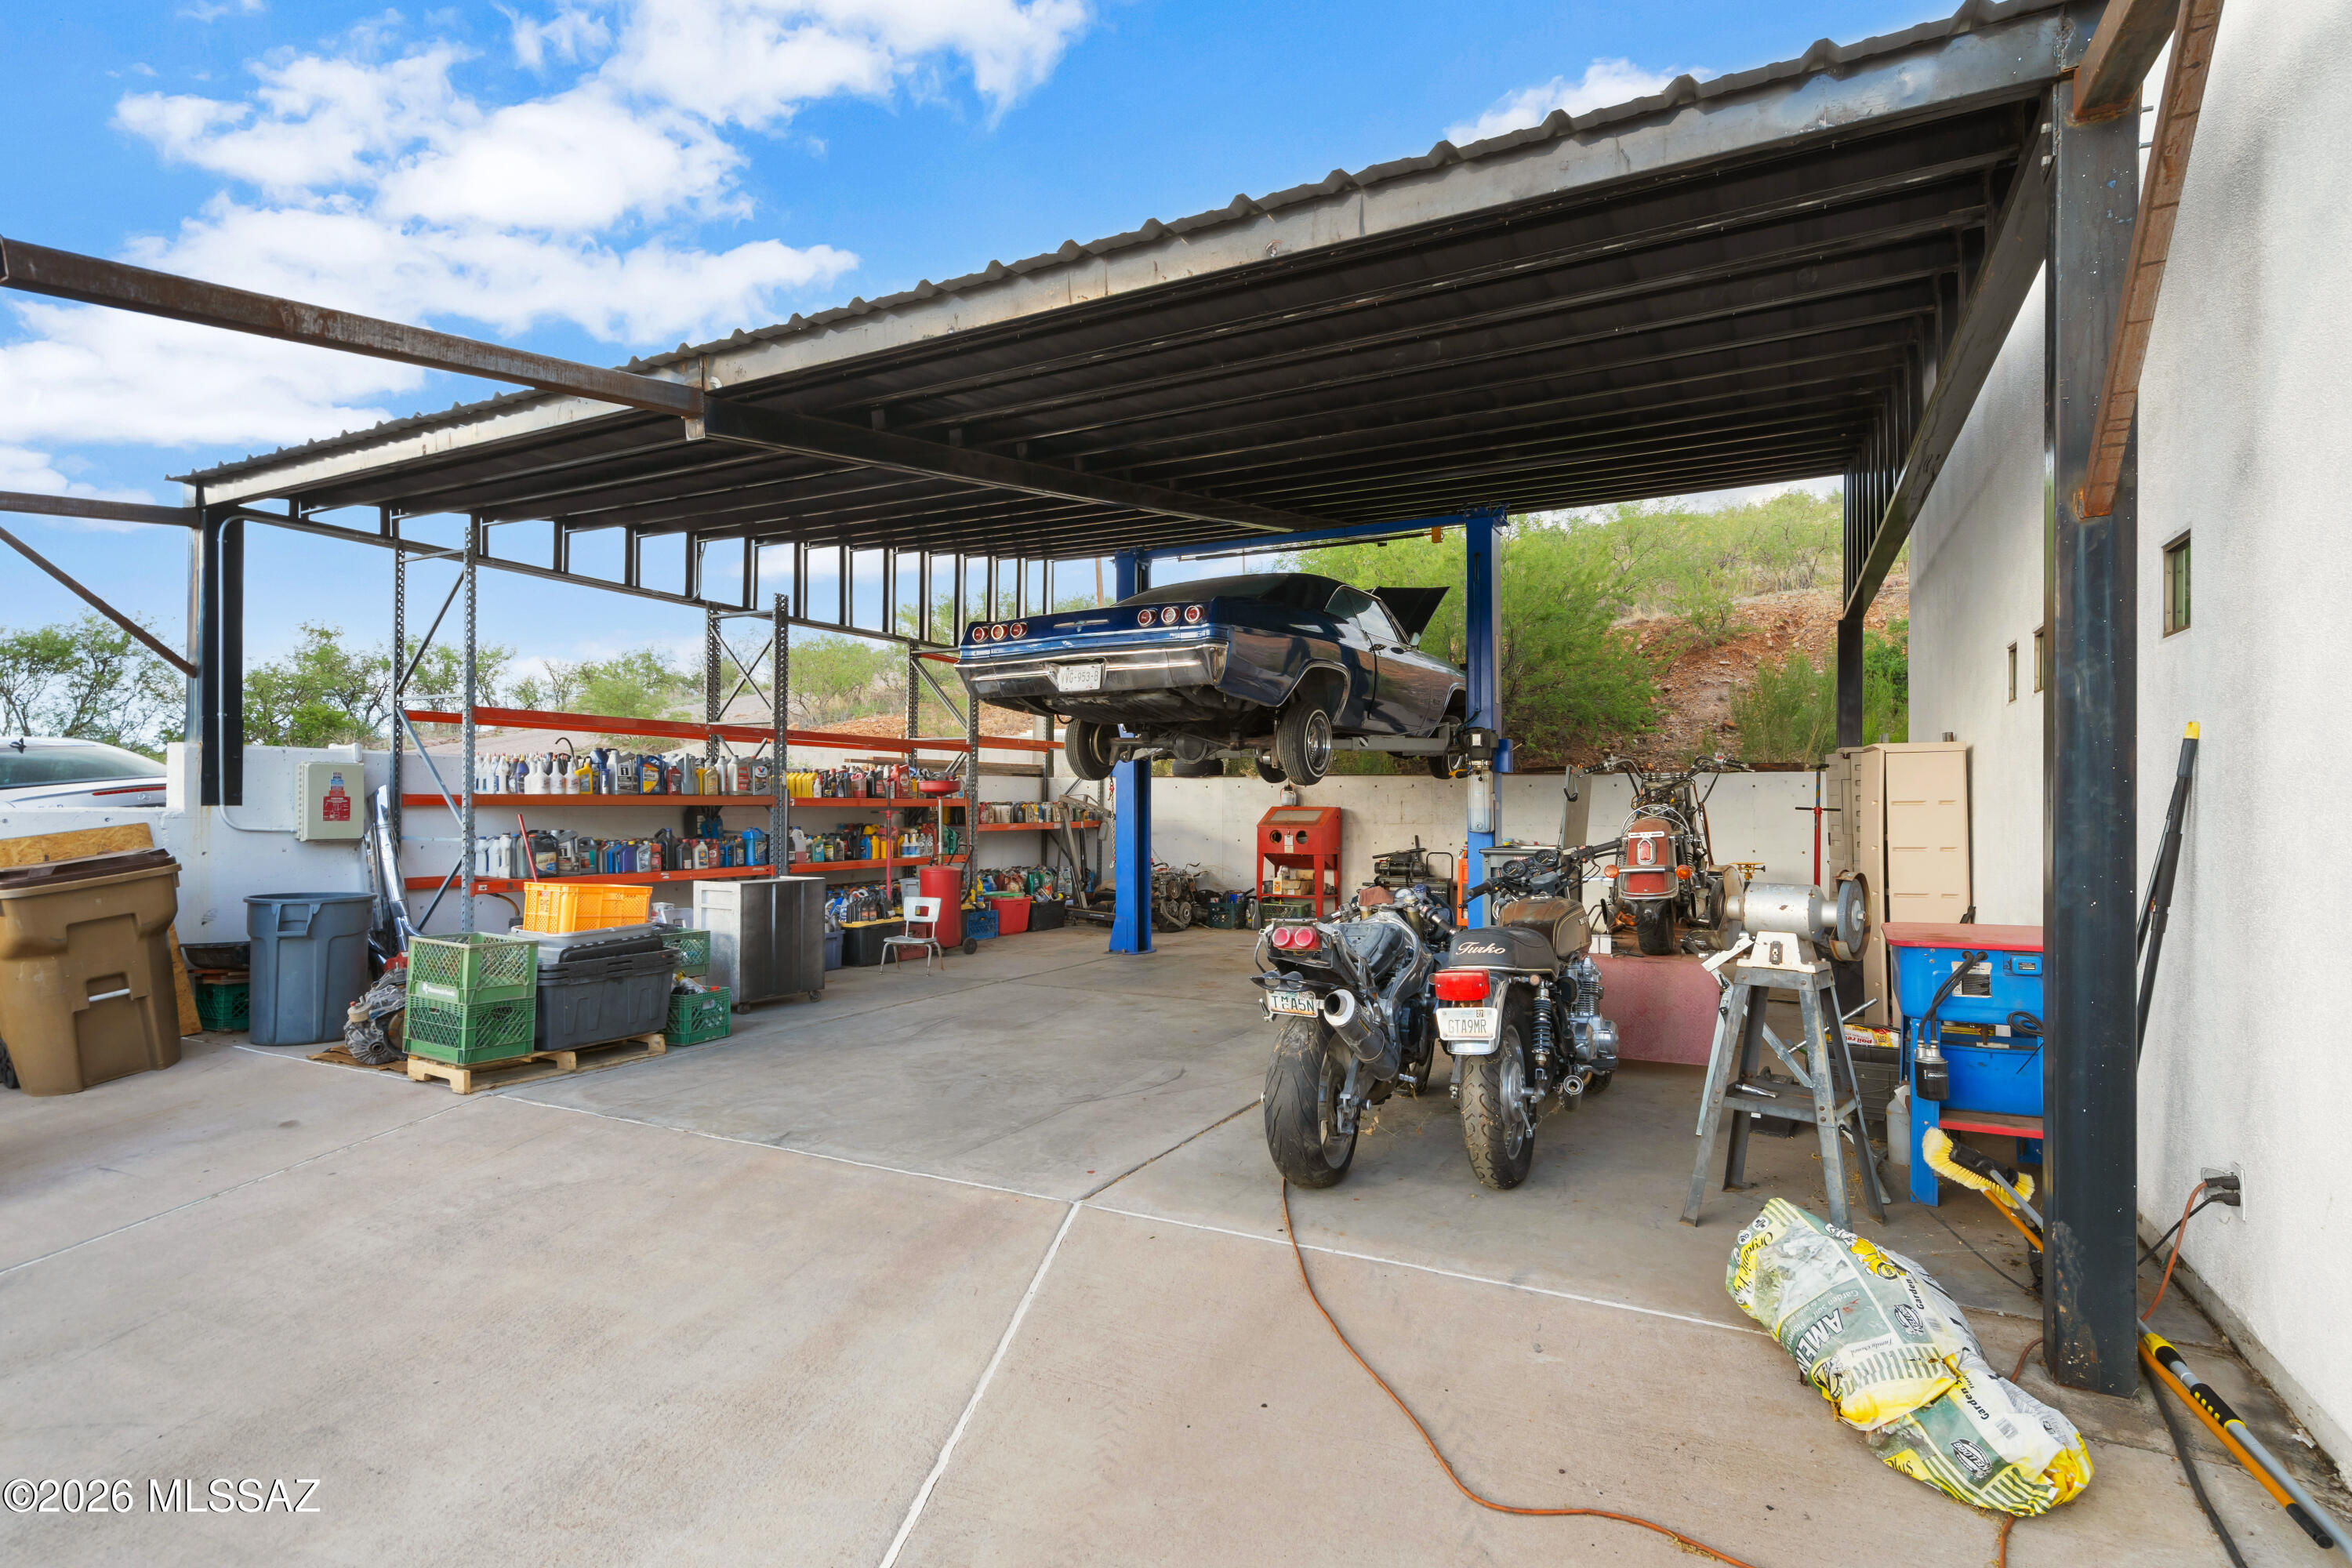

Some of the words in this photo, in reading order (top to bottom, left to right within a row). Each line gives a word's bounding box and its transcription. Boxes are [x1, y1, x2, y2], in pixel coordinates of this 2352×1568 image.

[1455, 942, 1506, 956] Turko
[1448, 1019, 1486, 1034] GTA9MR
[1828, 1290, 1859, 1306] Garden
[1907, 1278, 1925, 1310] Garden
[1961, 1388, 1990, 1420] Garden
[1953, 1442, 1991, 1471] KELLOGG
